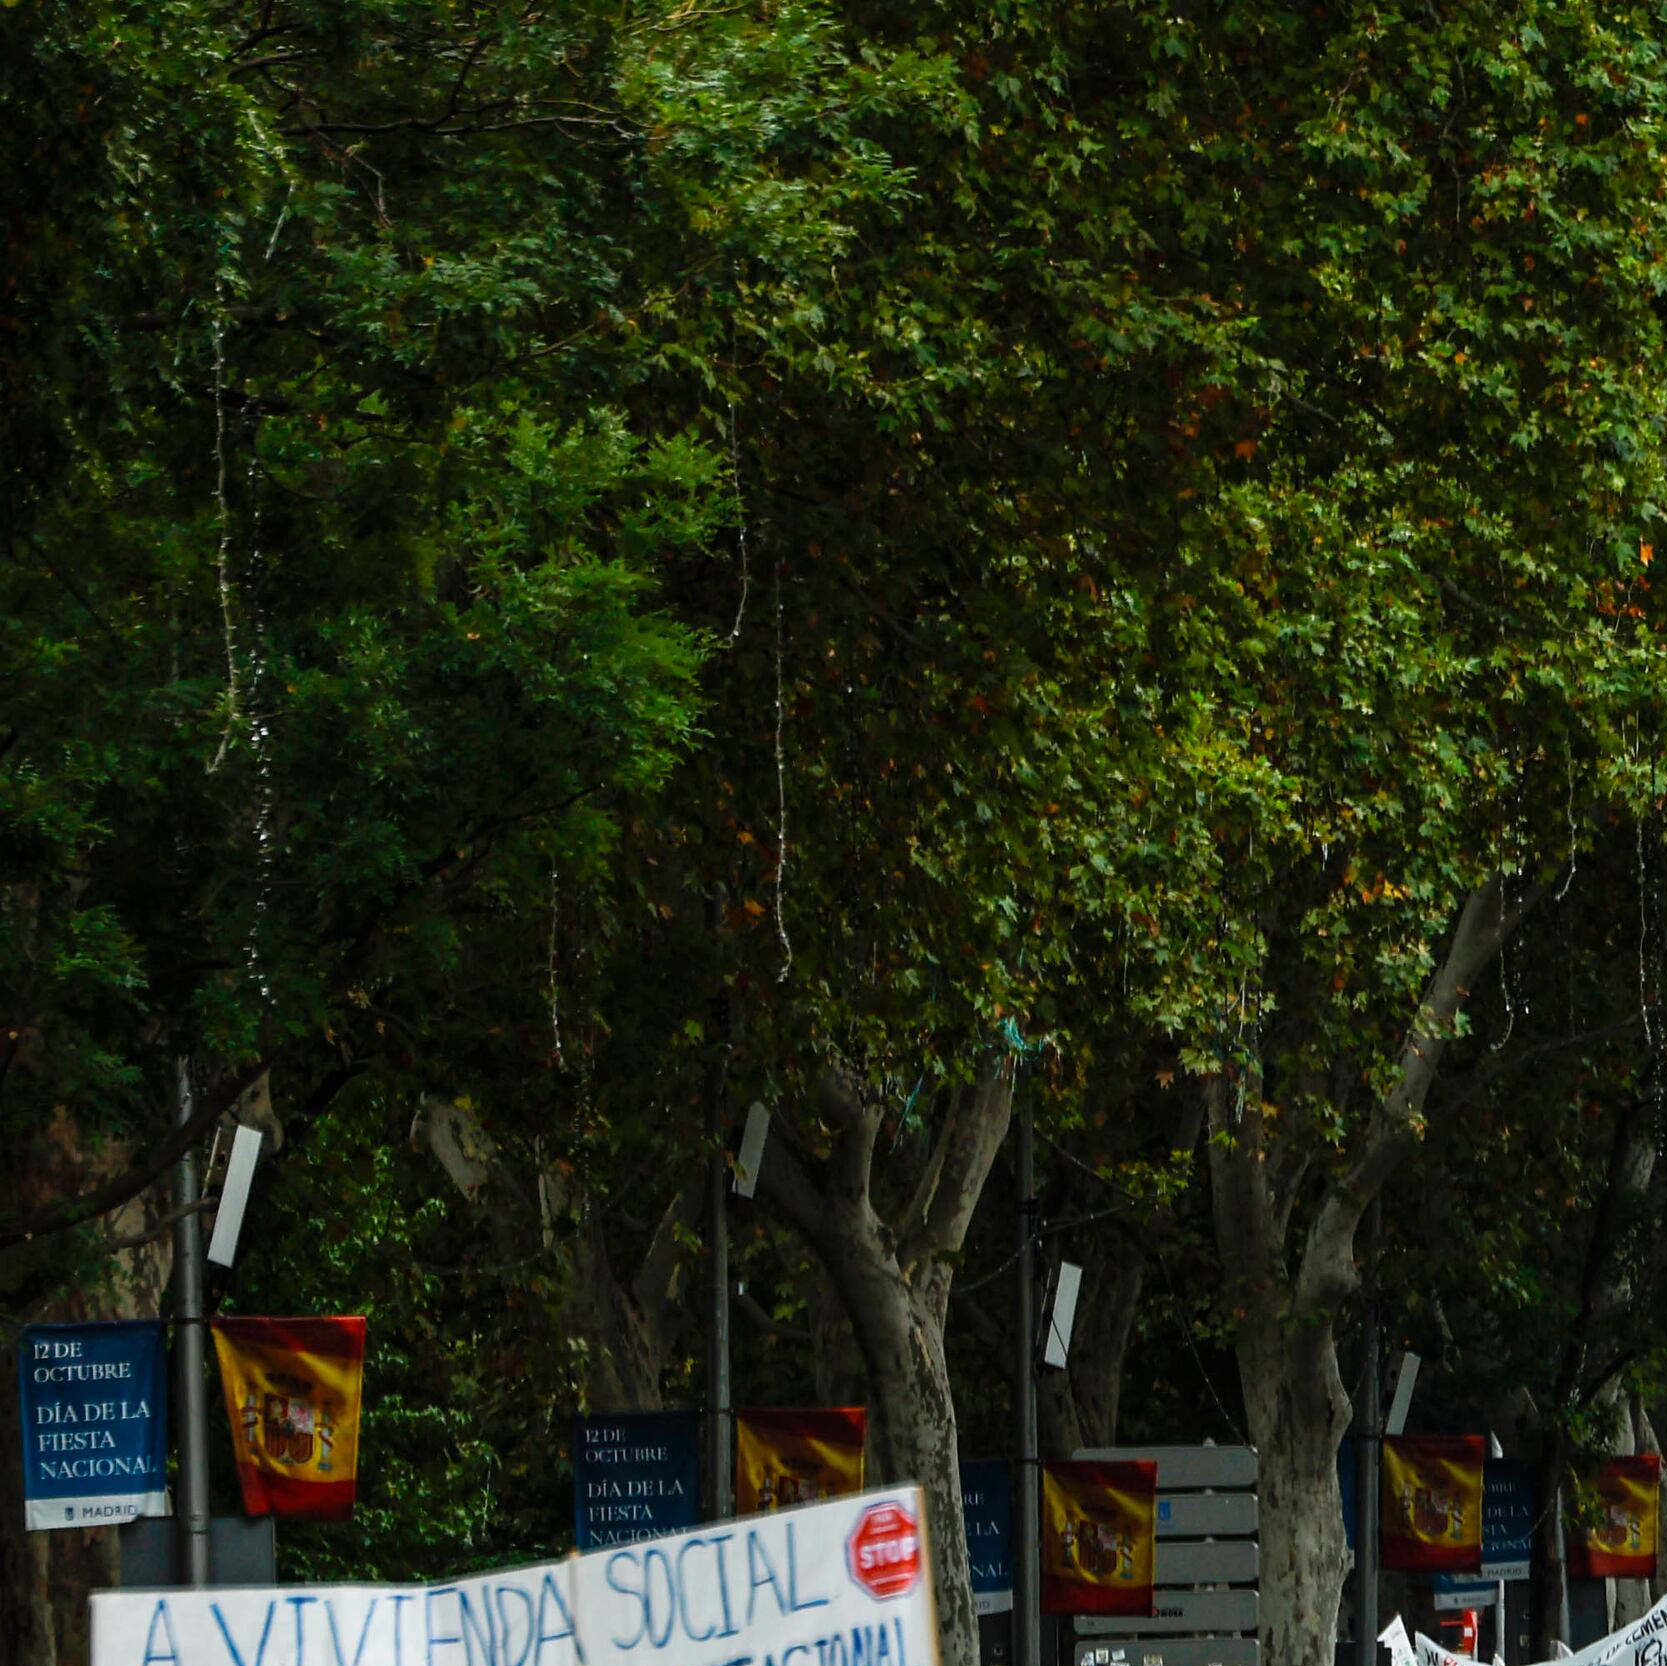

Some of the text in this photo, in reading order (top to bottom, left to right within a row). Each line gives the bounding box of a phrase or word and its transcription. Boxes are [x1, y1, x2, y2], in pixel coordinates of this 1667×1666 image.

[33, 1342, 83, 1360] 12 DE
[33, 1362, 132, 1384] OCTUBRE
[37, 1399, 151, 1425] DÍA DE LA
[37, 1431, 117, 1452] FIESTA
[585, 1427, 627, 1444] 12 DE
[585, 1447, 669, 1465] OCTUBRE
[39, 1455, 156, 1481] NACIONAL
[588, 1478, 685, 1499] DÍA DE LA
[82, 1504, 138, 1520] MADRID
[588, 1503, 654, 1522] FIESTA
[859, 1535, 918, 1569] STOP
[605, 1521, 830, 1651] SOCIAL
